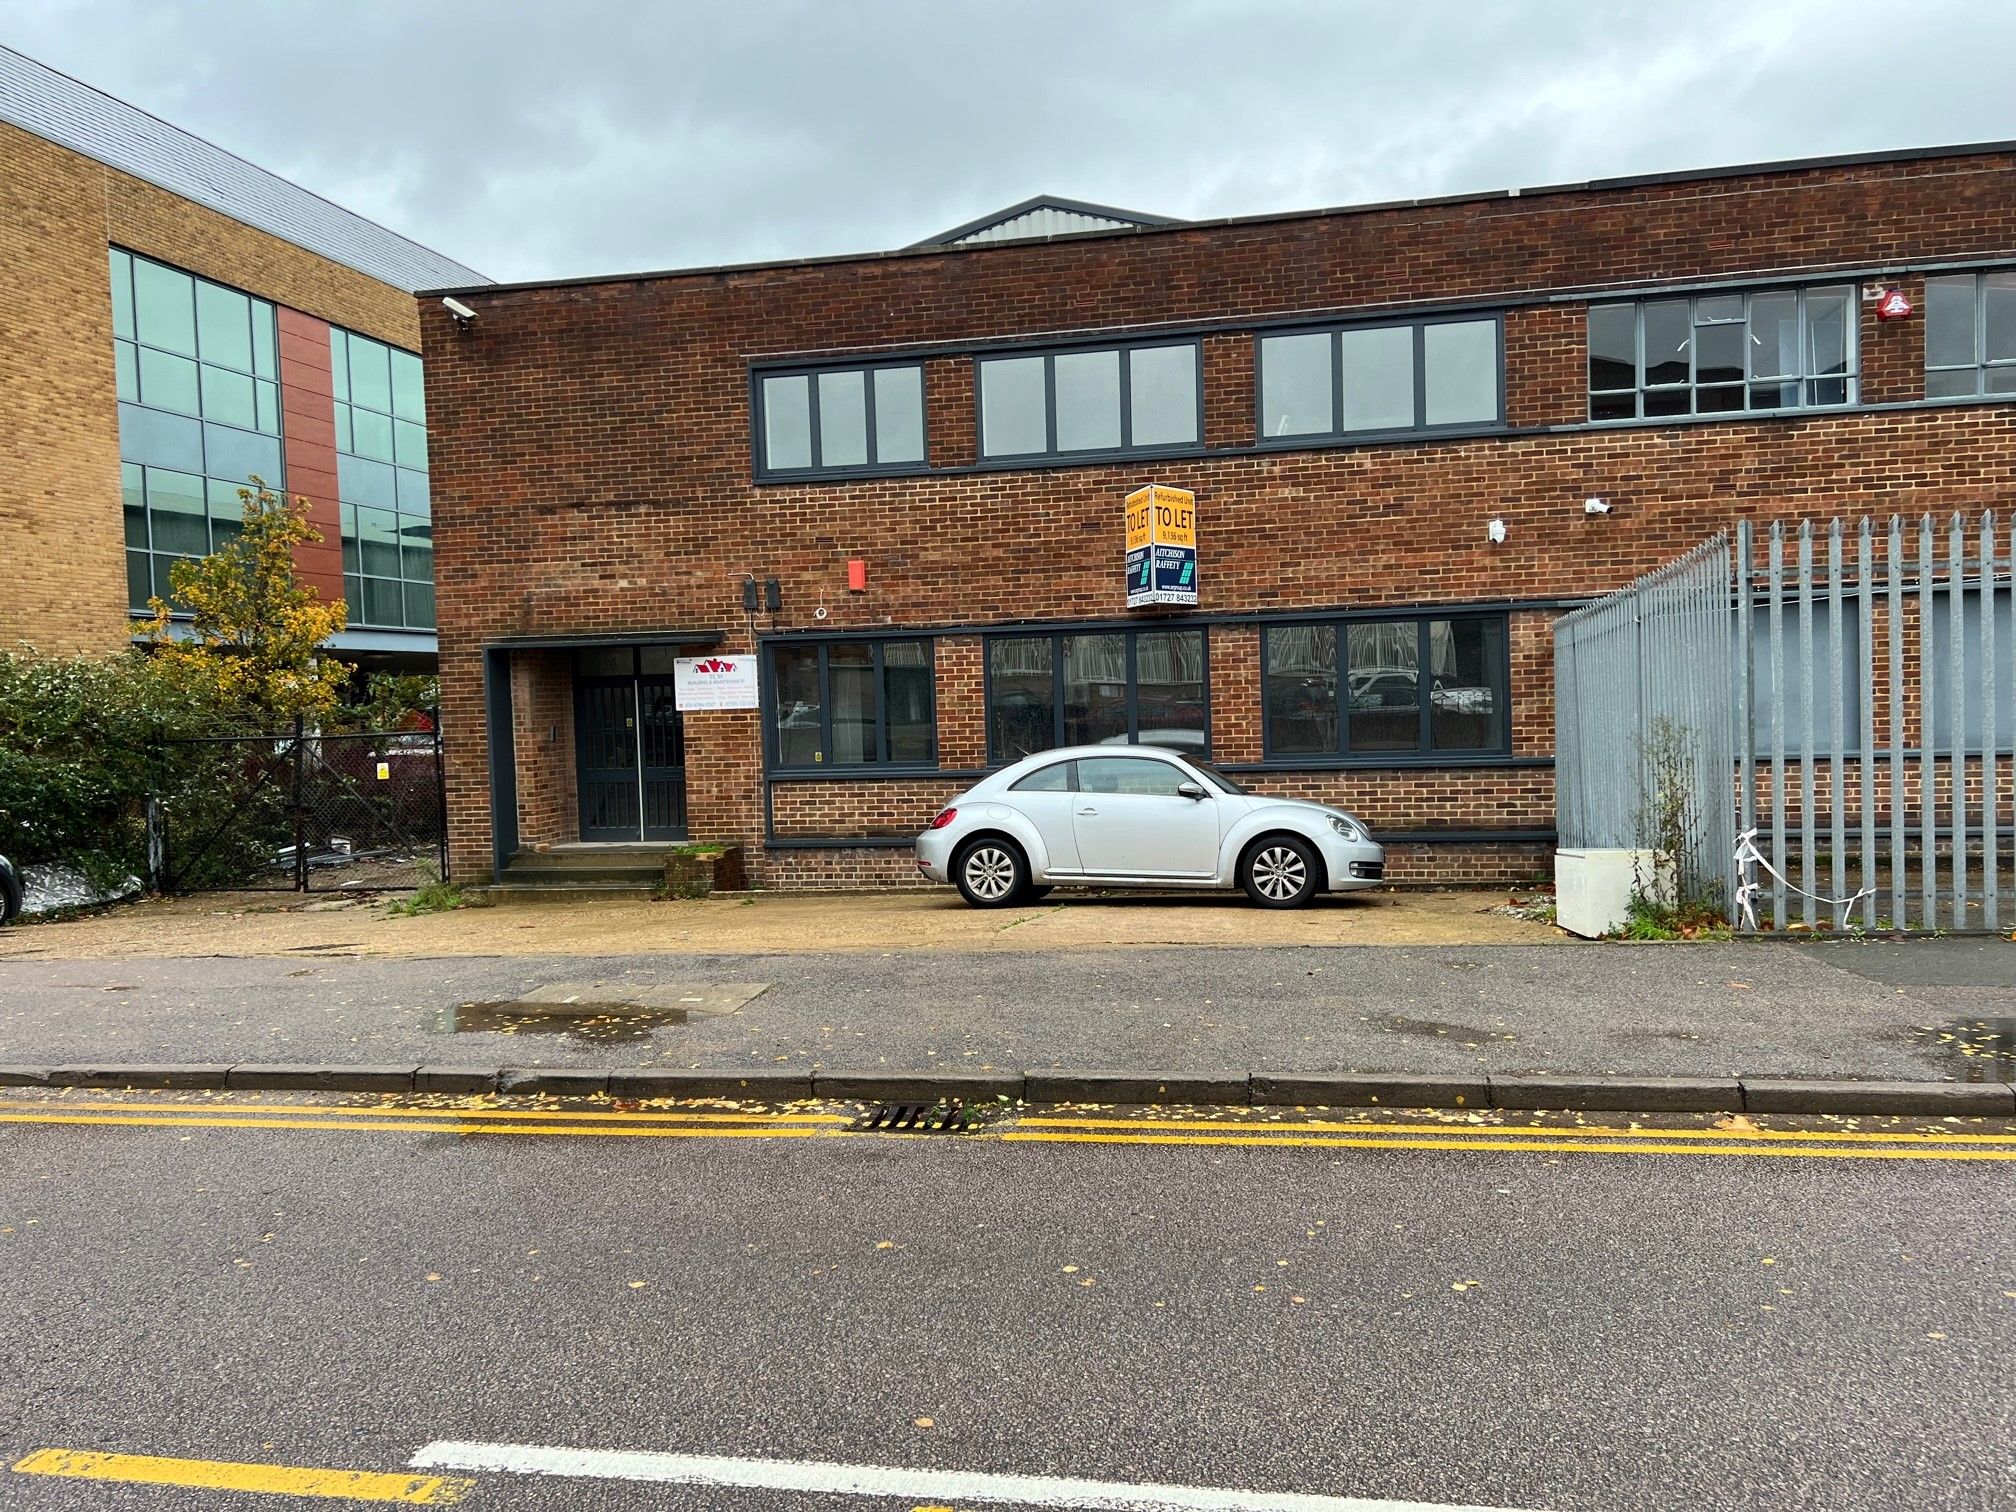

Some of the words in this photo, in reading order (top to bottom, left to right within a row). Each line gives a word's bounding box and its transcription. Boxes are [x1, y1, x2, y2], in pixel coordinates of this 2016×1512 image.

[1154, 491, 1183, 504] Refurbished
[1184, 498, 1194, 506] Unit
[1127, 513, 1136, 533] TO
[1136, 507, 1149, 529] LET
[1155, 506, 1172, 526] TO
[1174, 508, 1193, 529] LET
[1162, 531, 1177, 541] 9,136
[1183, 533, 1188, 541] ft
[1155, 548, 1185, 559] AITCHISON
[1155, 560, 1180, 570] RAFFETY
[1156, 592, 1175, 602] 01727
[1176, 594, 1197, 603] 843232
